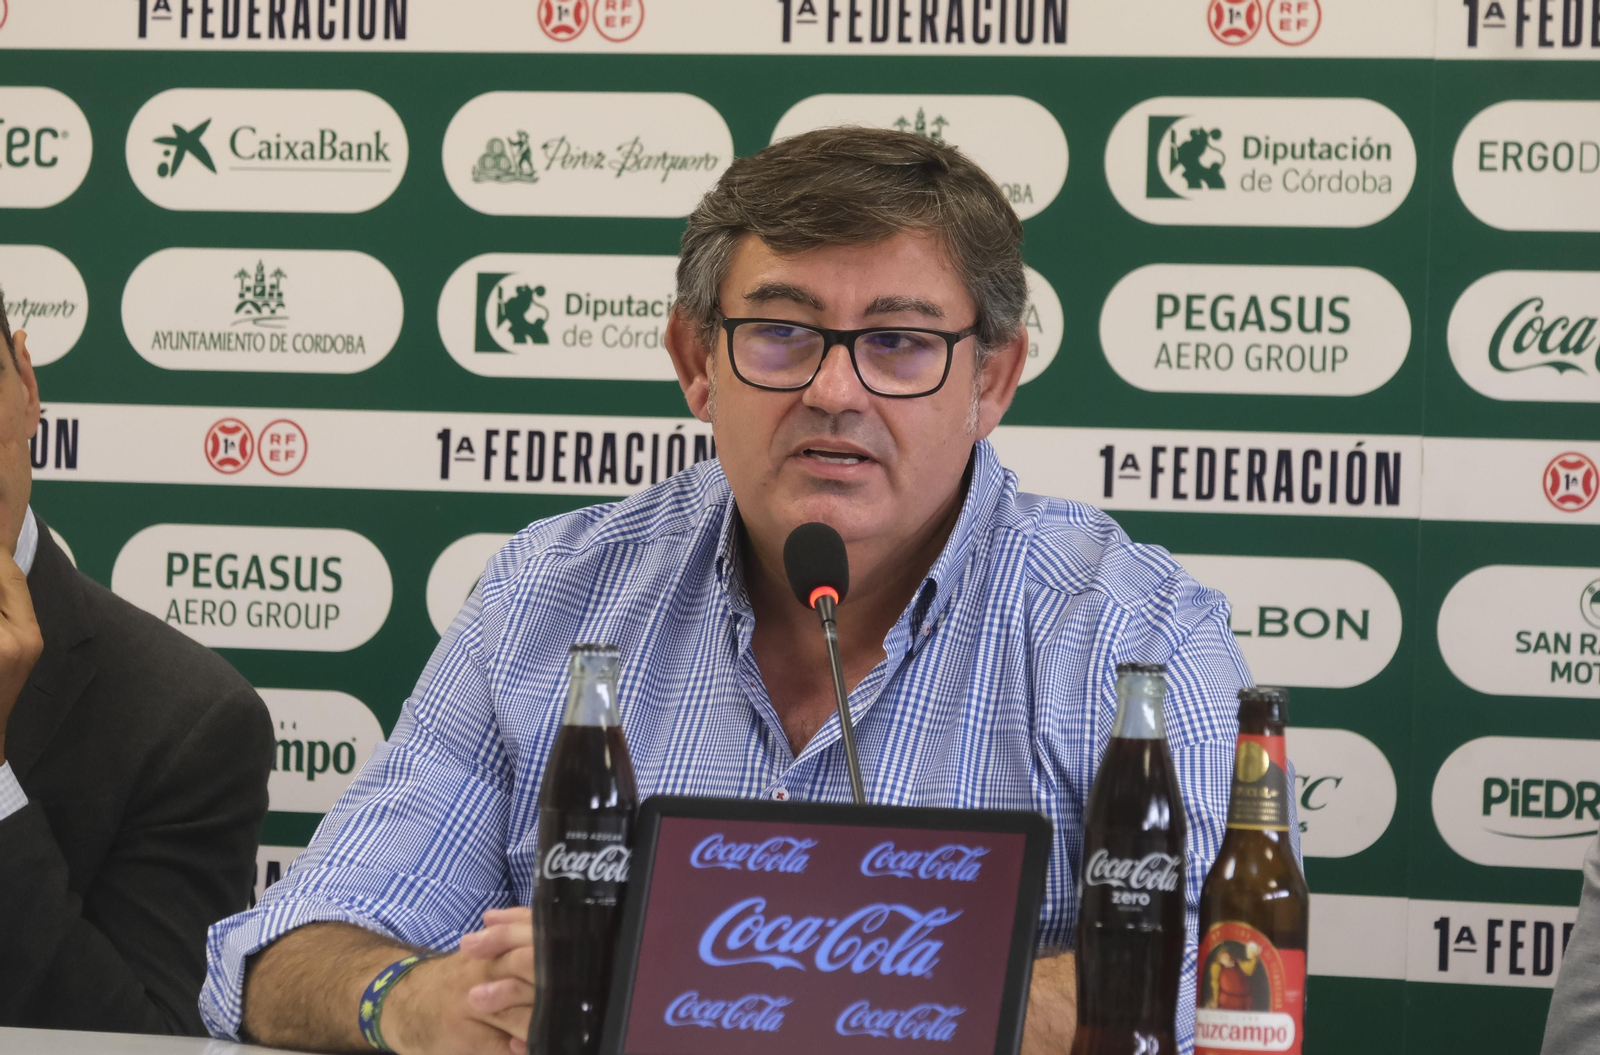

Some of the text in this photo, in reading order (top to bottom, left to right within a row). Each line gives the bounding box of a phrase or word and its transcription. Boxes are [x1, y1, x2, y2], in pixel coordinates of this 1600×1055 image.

[229, 126, 391, 163] CaixaBank
[608, 135, 720, 184] Barquero
[1242, 135, 1393, 166] Diputación
[1240, 167, 1394, 195] de Córdoba
[1155, 293, 1351, 334] PEGASUS
[151, 331, 366, 355] AYUNTAMIENTO DE CORDOBA
[562, 325, 592, 348] de
[1488, 297, 1600, 376] Coca
[1154, 342, 1349, 373] AERO GROUP
[1150, 441, 1402, 507] FEDERACIÓN
[166, 552, 343, 592] PEGASUS
[164, 598, 341, 630] AERO GROUP
[1515, 631, 1600, 655] SAN R
[690, 833, 819, 874] Coca-Cola
[861, 841, 992, 882] Coca-Cola
[1085, 848, 1181, 892] Coca-Cola
[1111, 890, 1151, 906] zero
[699, 897, 964, 979] Coca-Cola
[664, 990, 794, 1033] Coca-Cola
[835, 1001, 966, 1042] Coca-Cola
